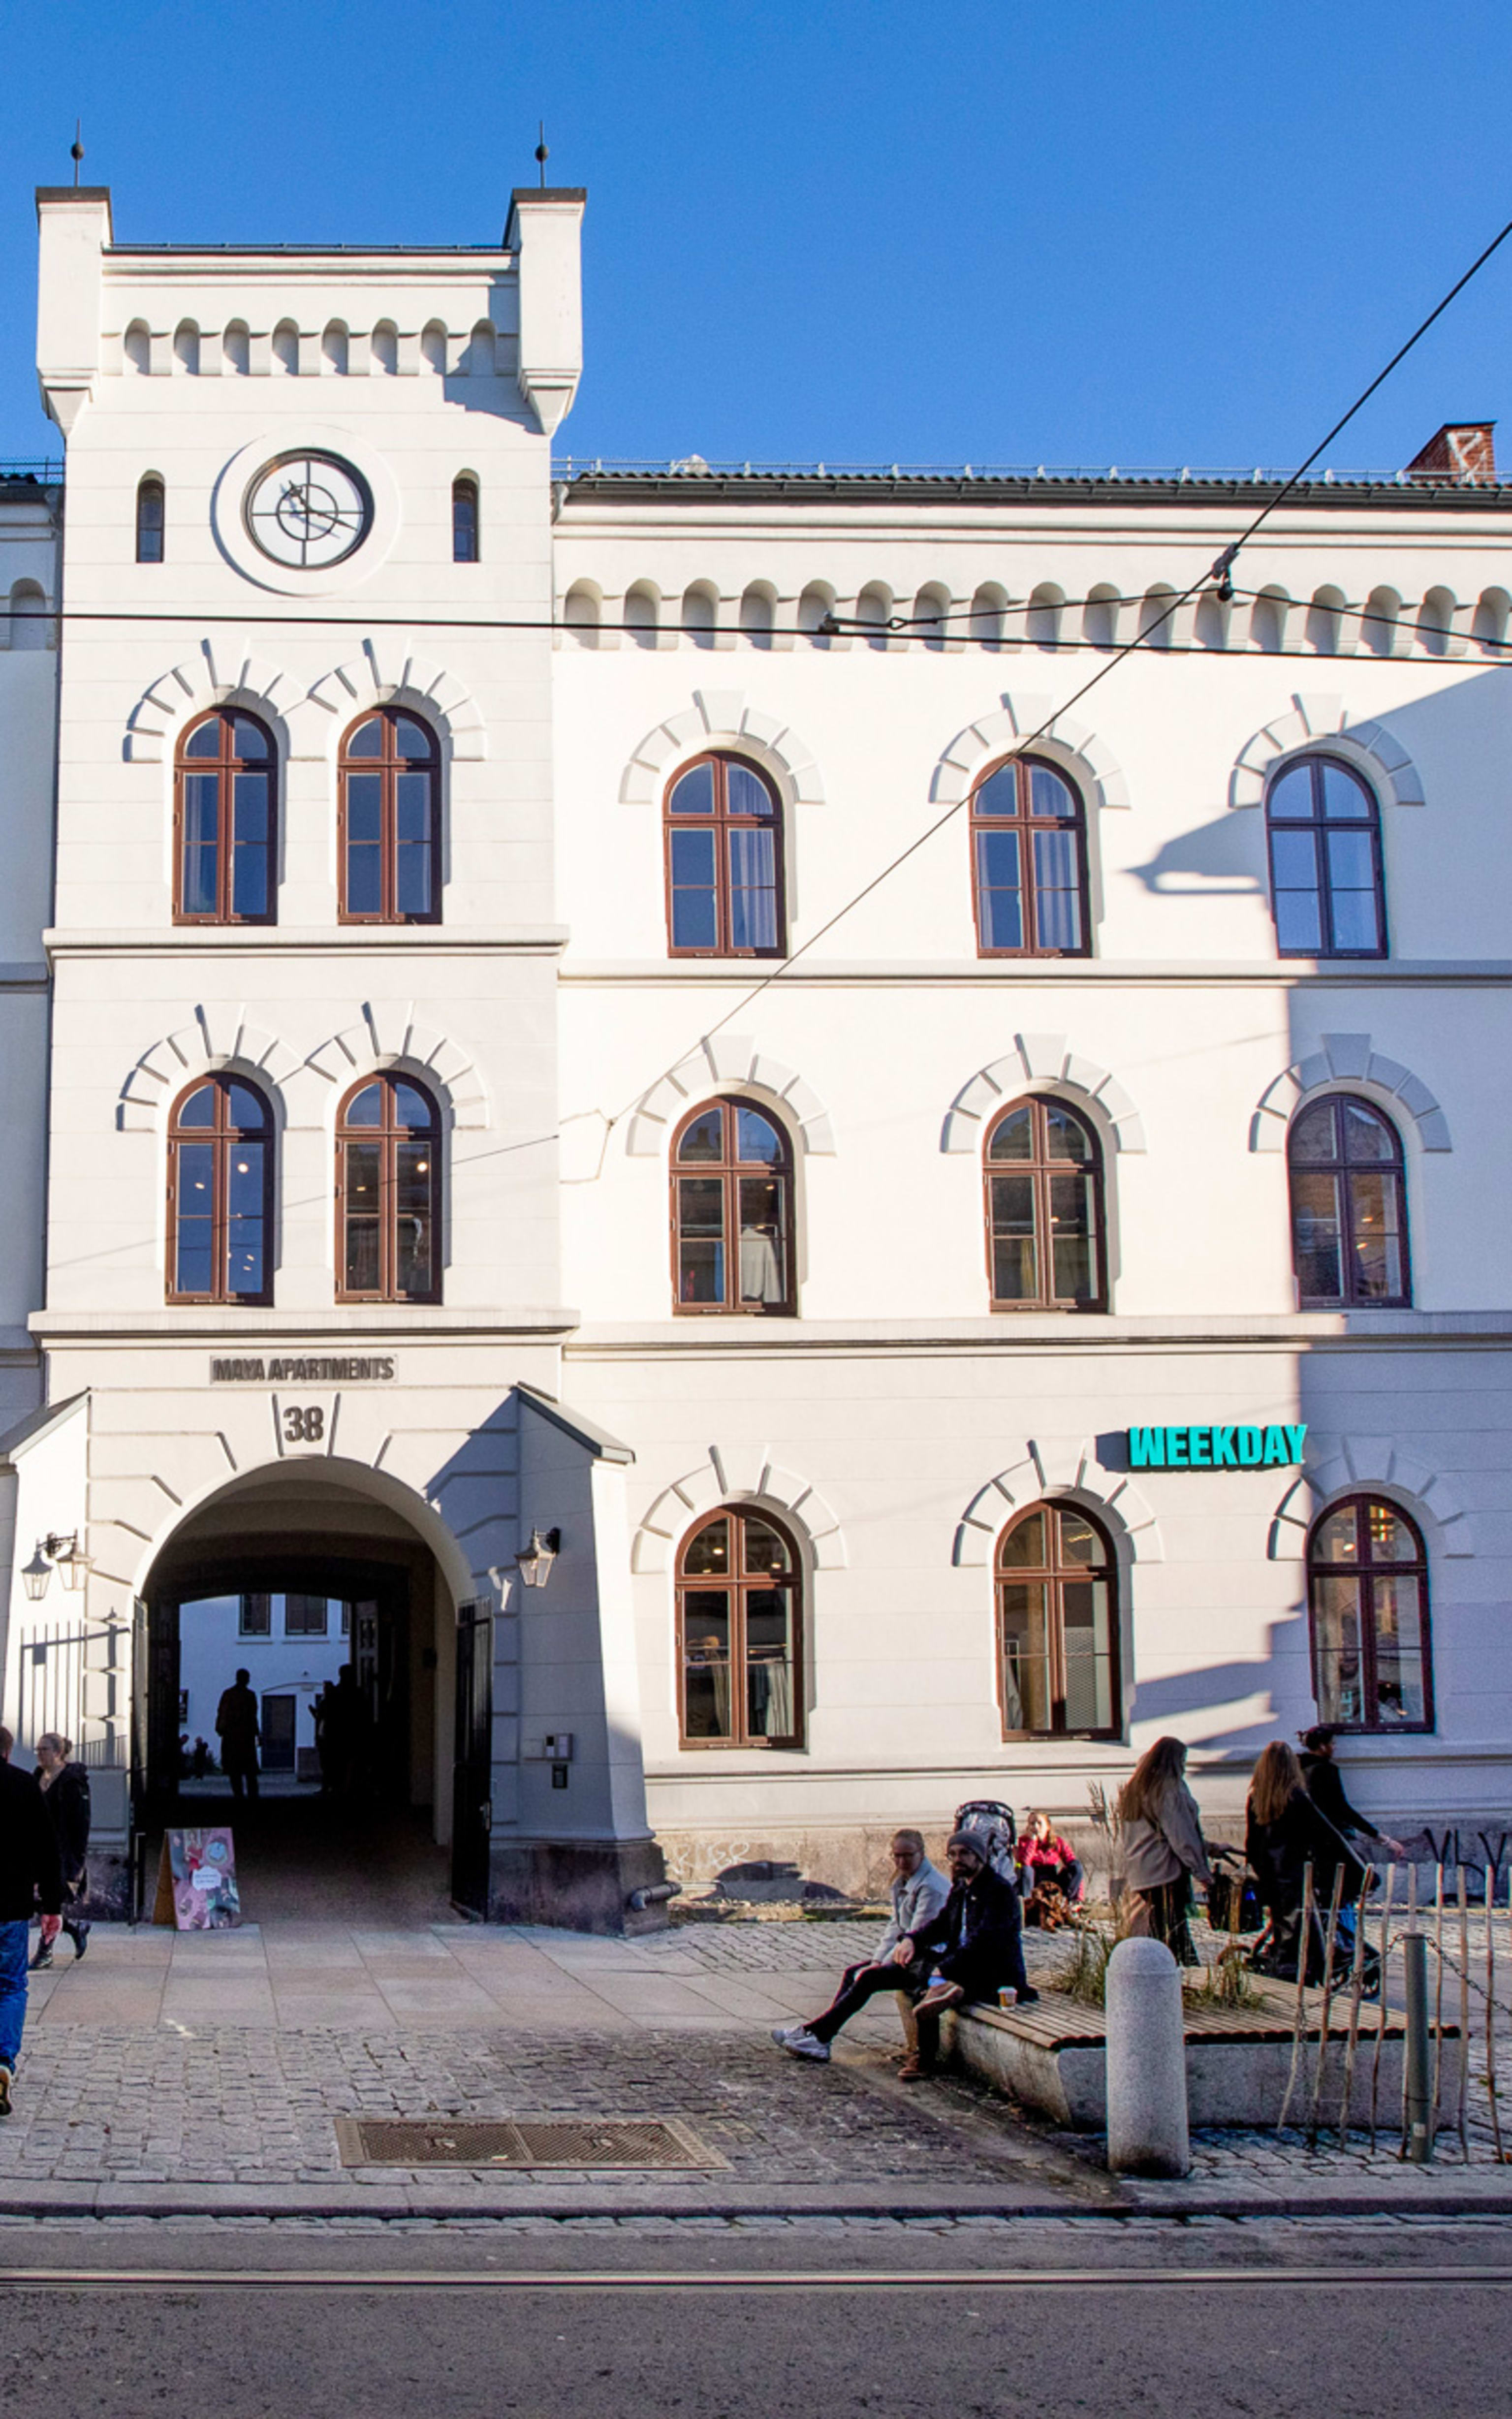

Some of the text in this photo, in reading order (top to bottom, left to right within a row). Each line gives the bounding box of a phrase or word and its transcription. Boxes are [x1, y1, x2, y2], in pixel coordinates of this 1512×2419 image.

[213, 1357, 394, 1381] MAYA APARTMENTS
[283, 1406, 324, 1443] 38
[1128, 1424, 1308, 1467] WEEKDAY
